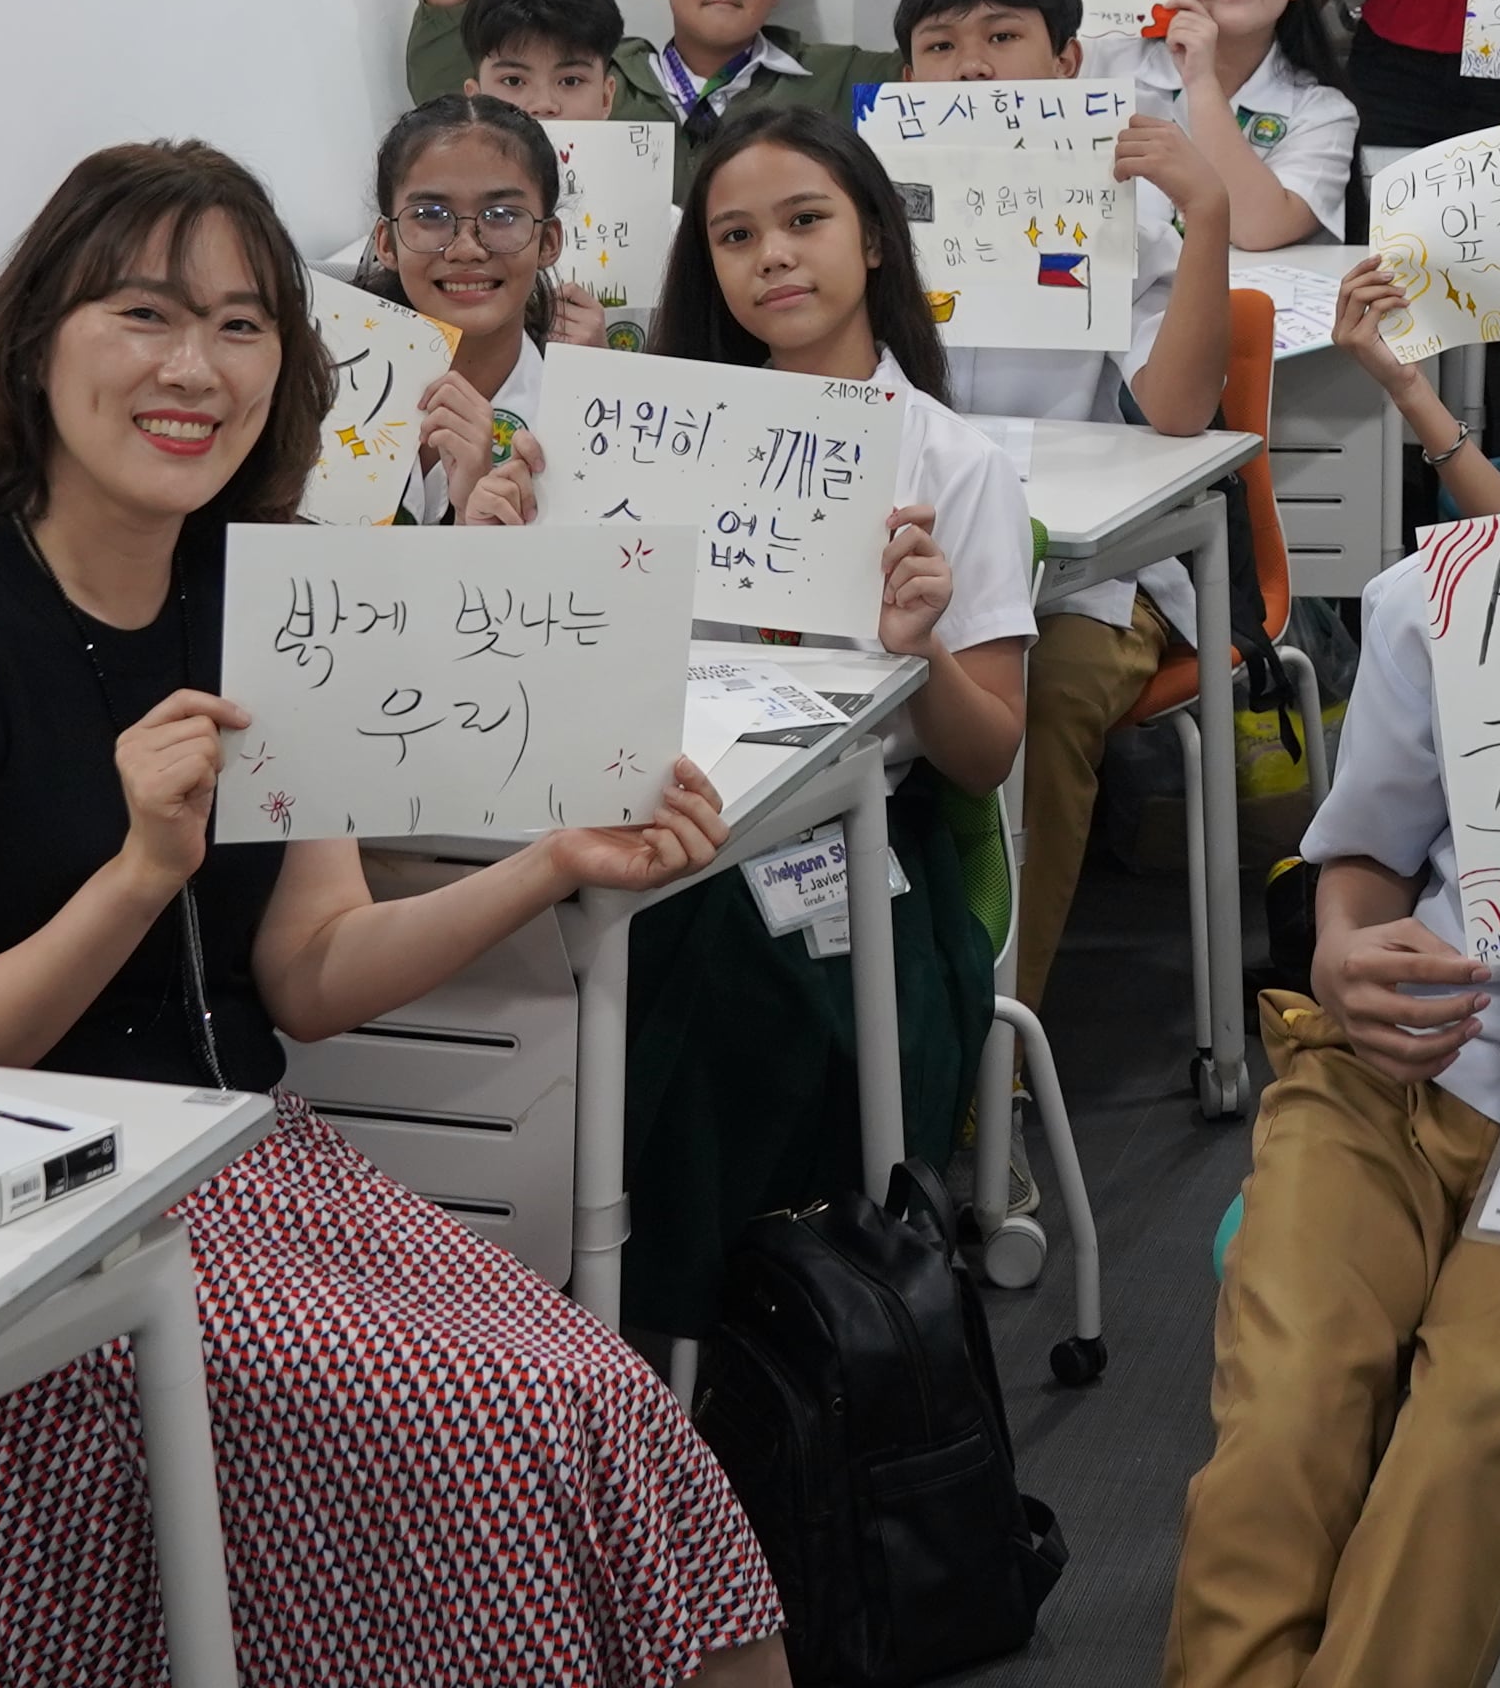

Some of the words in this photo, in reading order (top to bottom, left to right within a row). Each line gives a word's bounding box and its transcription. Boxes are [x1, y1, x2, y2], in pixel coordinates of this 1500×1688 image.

[881, 90, 1126, 140] 감사합니다
[597, 221, 630, 250] 우린
[584, 398, 713, 464] 영원히
[759, 427, 861, 500] 깨질
[710, 511, 802, 574] 없는
[275, 577, 407, 689] 밝게
[452, 580, 611, 661] 빛나는
[357, 680, 530, 793] 우리
[803, 893, 826, 907] Grade
